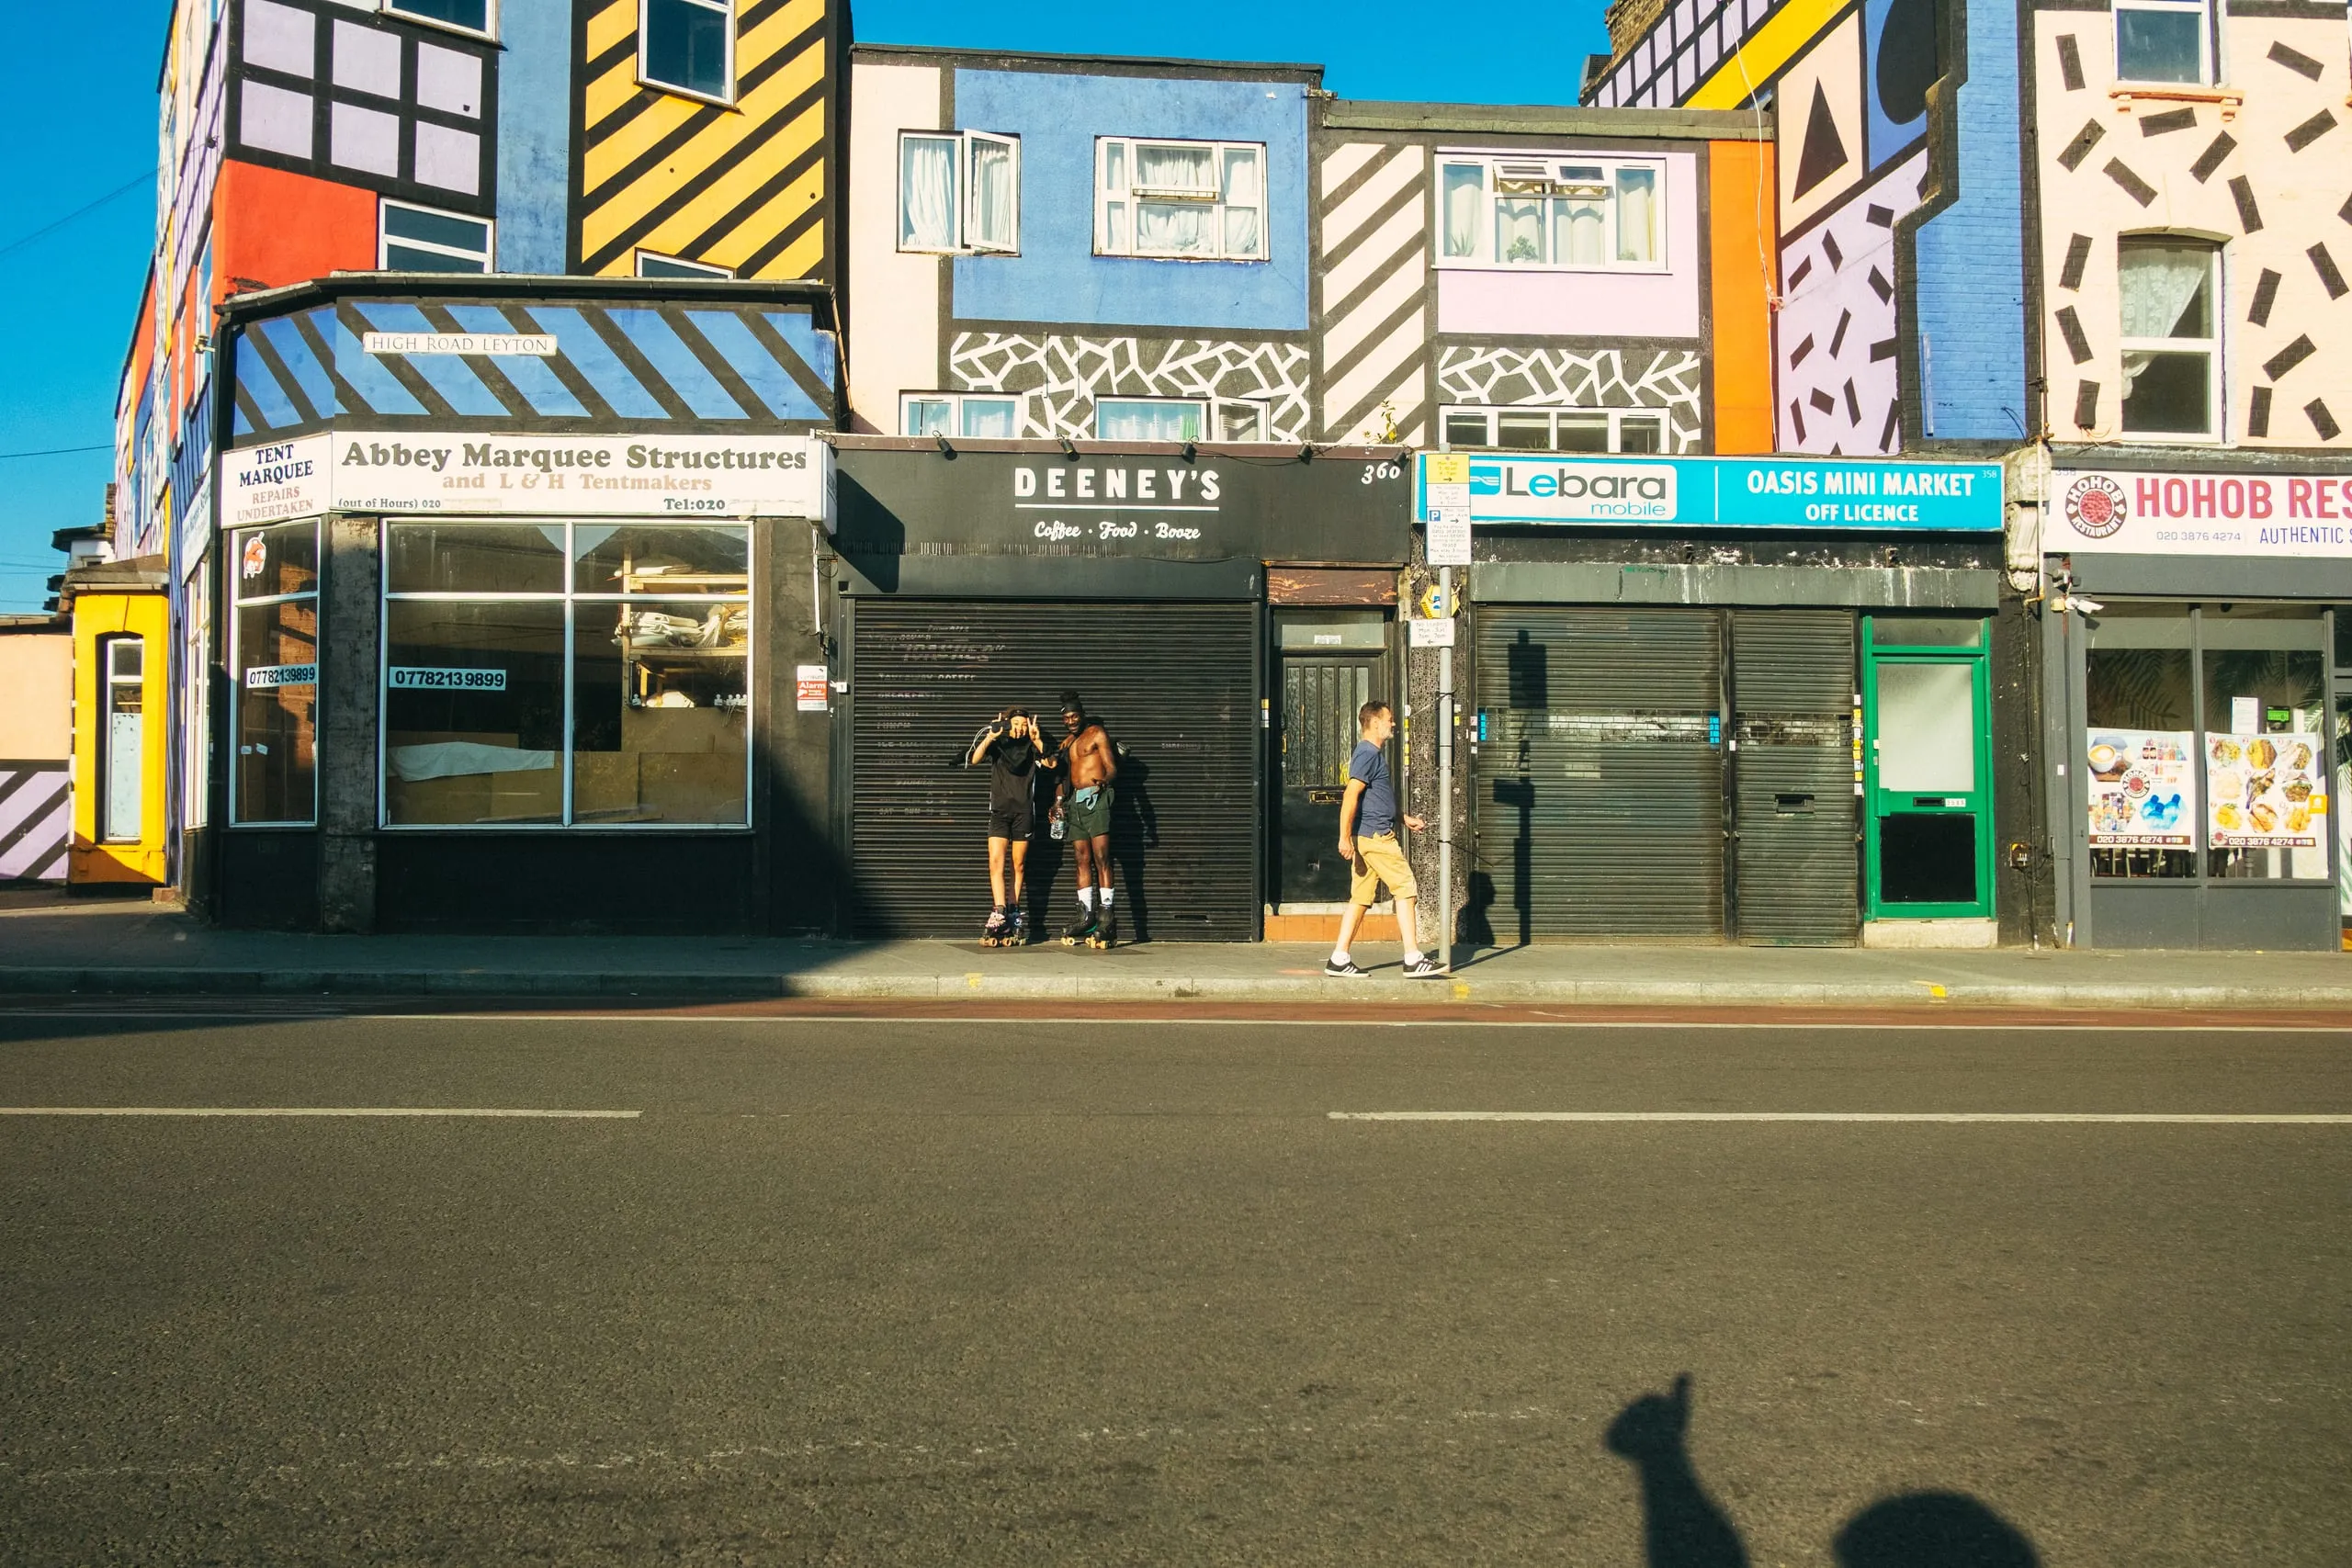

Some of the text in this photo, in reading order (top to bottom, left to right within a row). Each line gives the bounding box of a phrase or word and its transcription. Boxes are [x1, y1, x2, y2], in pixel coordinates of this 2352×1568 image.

[371, 336, 548, 351] HIGH ROAD LEYTON
[255, 444, 294, 465] TENT
[341, 442, 806, 472] Abbey Marquee Structures
[239, 459, 313, 487] MARQUEE
[442, 473, 713, 491] and L & H Tentmakers
[1361, 462, 1401, 485] 360
[1982, 469, 1997, 479] 358
[1015, 468, 1221, 501] DEENEY'S
[1506, 467, 1666, 500] Lebara
[1747, 469, 1975, 496] OASIS MINI MARKET
[2066, 476, 2124, 503] HOHOB
[252, 486, 300, 504] REPAIRS
[338, 498, 441, 509] (out of Hours) 020
[2136, 478, 2273, 519] HOHOB
[237, 499, 314, 522] UNDERTAKEN
[663, 498, 726, 511] Tel:020
[1591, 502, 1666, 516] mobile
[1805, 503, 1919, 522] OFF LICENCE
[1035, 521, 1202, 541] Coffee Food Booze
[2071, 515, 2123, 537] RESTAURANT
[2260, 526, 2344, 544] AUTHENTIC
[2156, 531, 2241, 541] 020 3876 4274
[249, 667, 316, 684] 07782139899
[395, 670, 505, 687] 07782139899
[2097, 835, 2114, 843] 020
[2115, 835, 2139, 843] 3876
[2271, 838, 2294, 846] 4274
